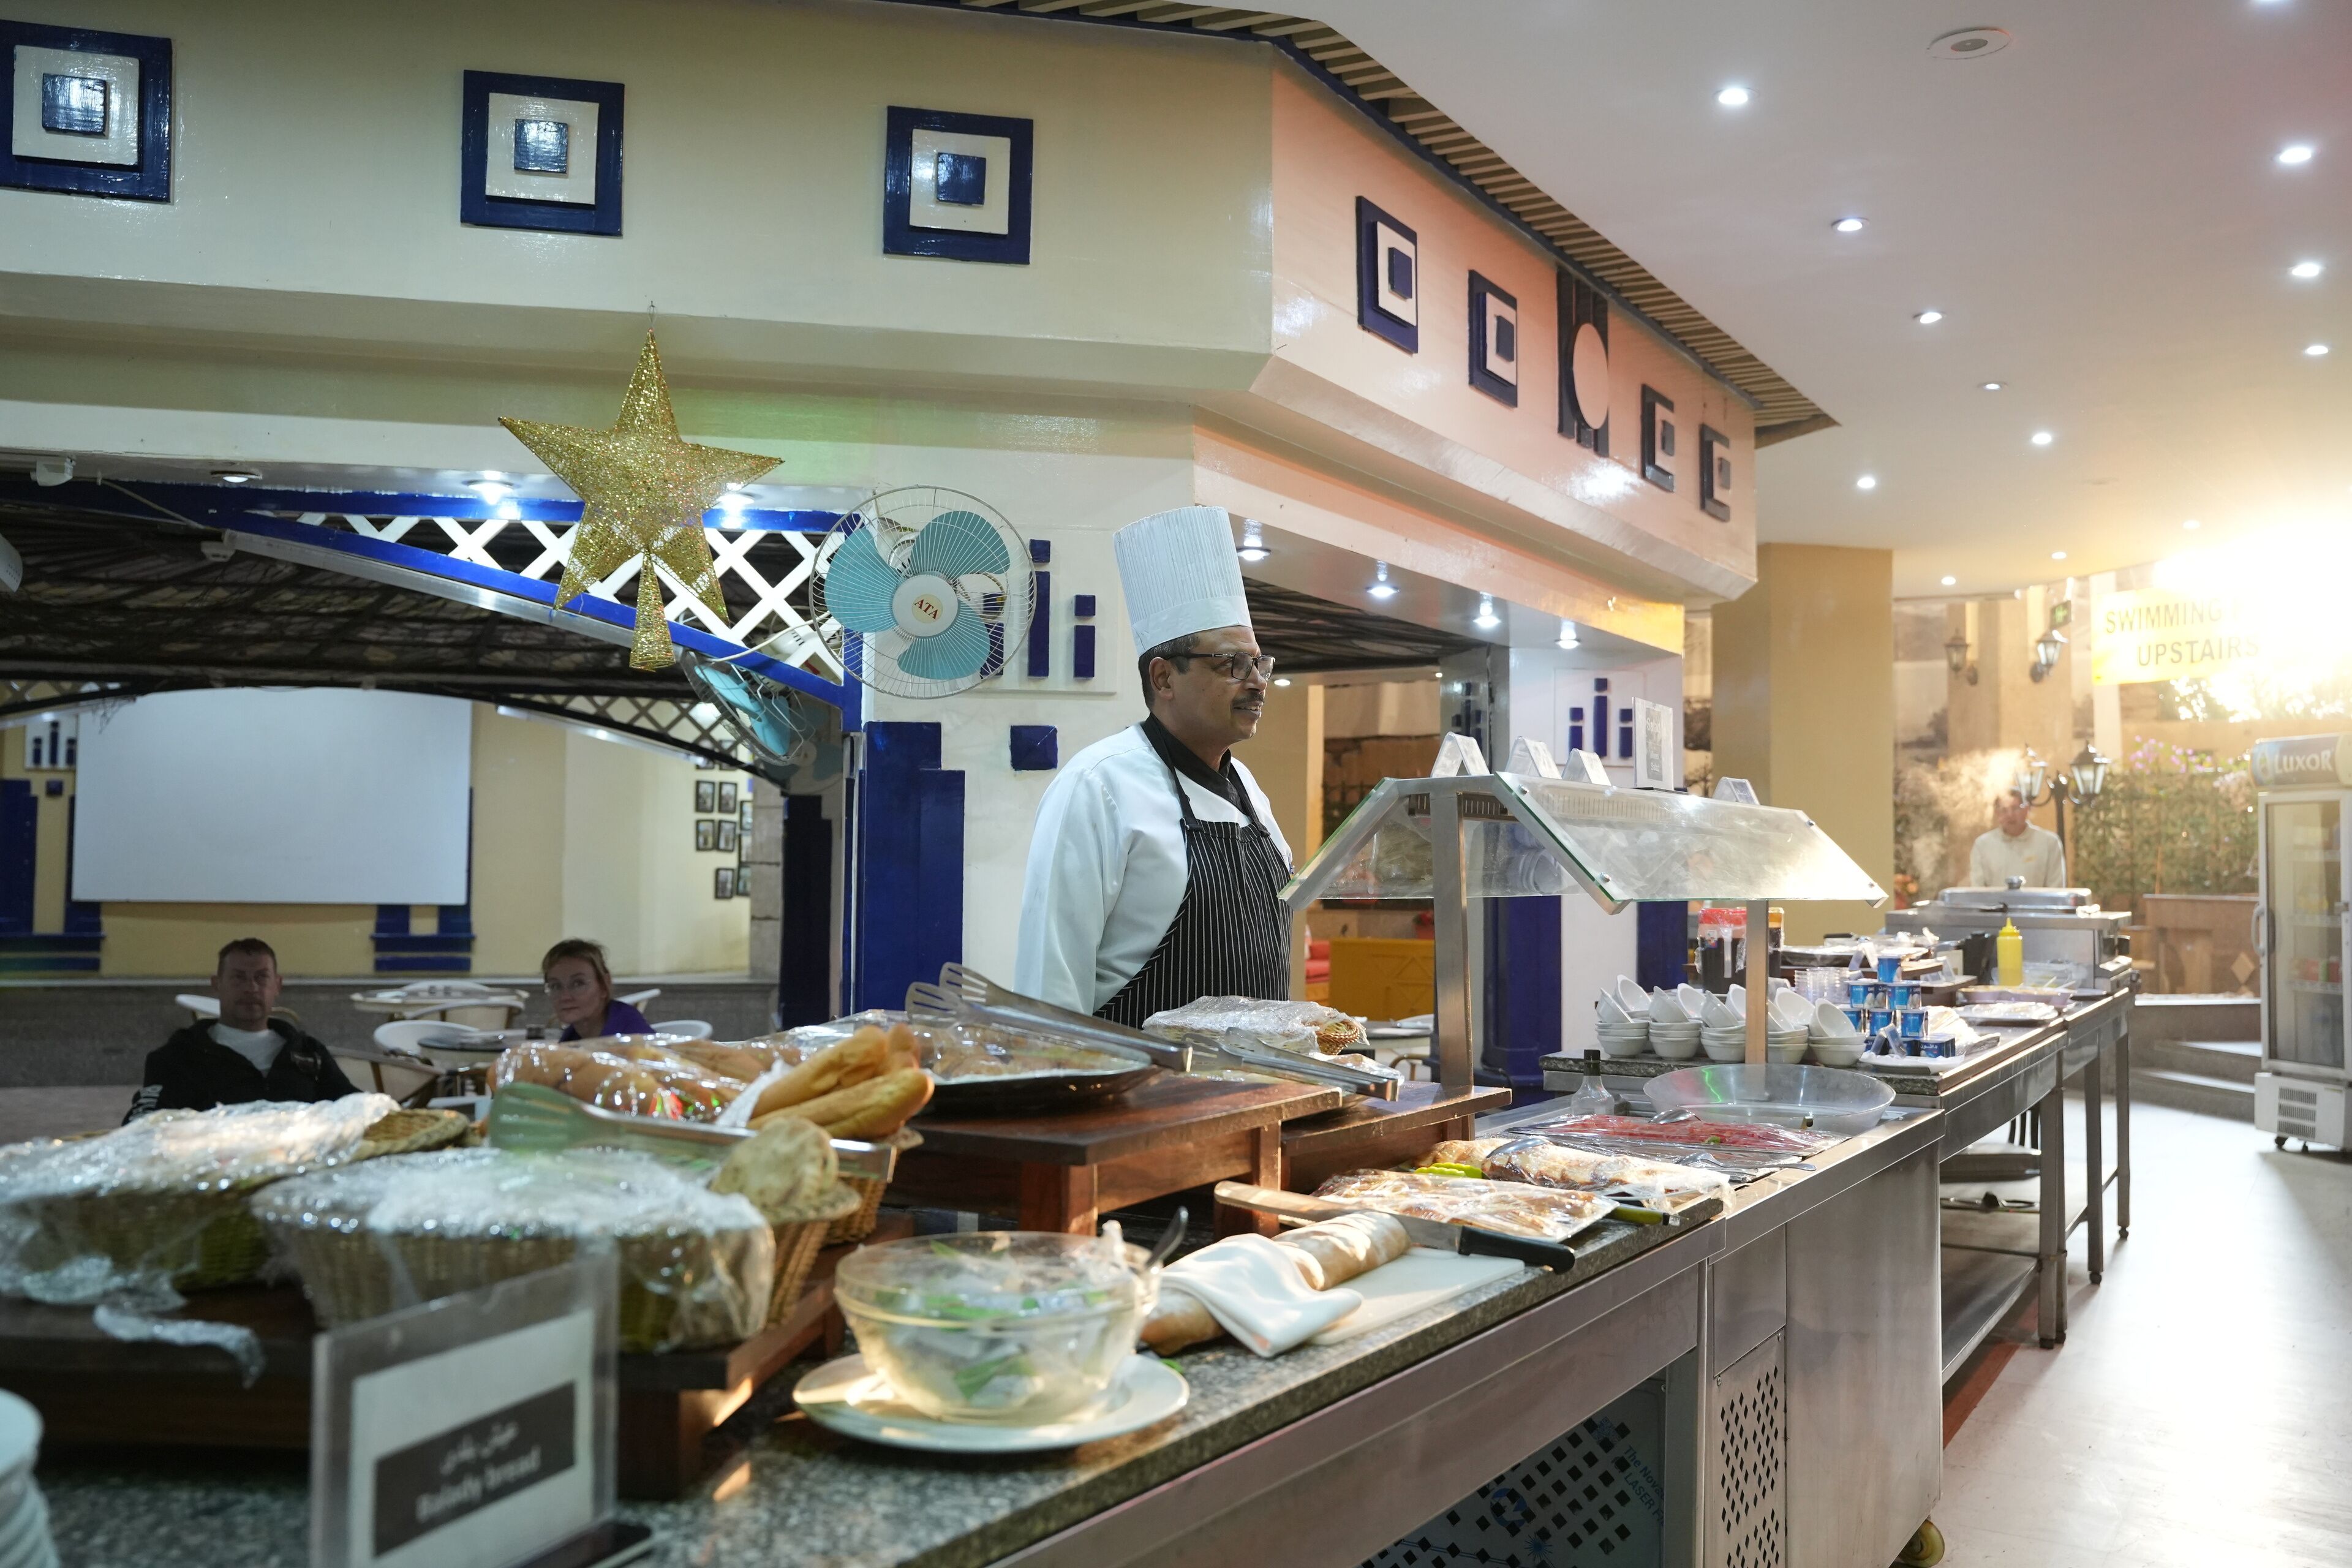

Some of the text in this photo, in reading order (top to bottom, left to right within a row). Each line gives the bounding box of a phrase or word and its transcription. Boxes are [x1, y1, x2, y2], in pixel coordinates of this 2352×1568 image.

[914, 598, 938, 620] ATA
[2106, 597, 2222, 633] SWIMMING
[2138, 635, 2259, 666] UPSTAIRS
[1624, 1446, 1641, 1468] The
[1624, 1472, 1655, 1510] LASER
